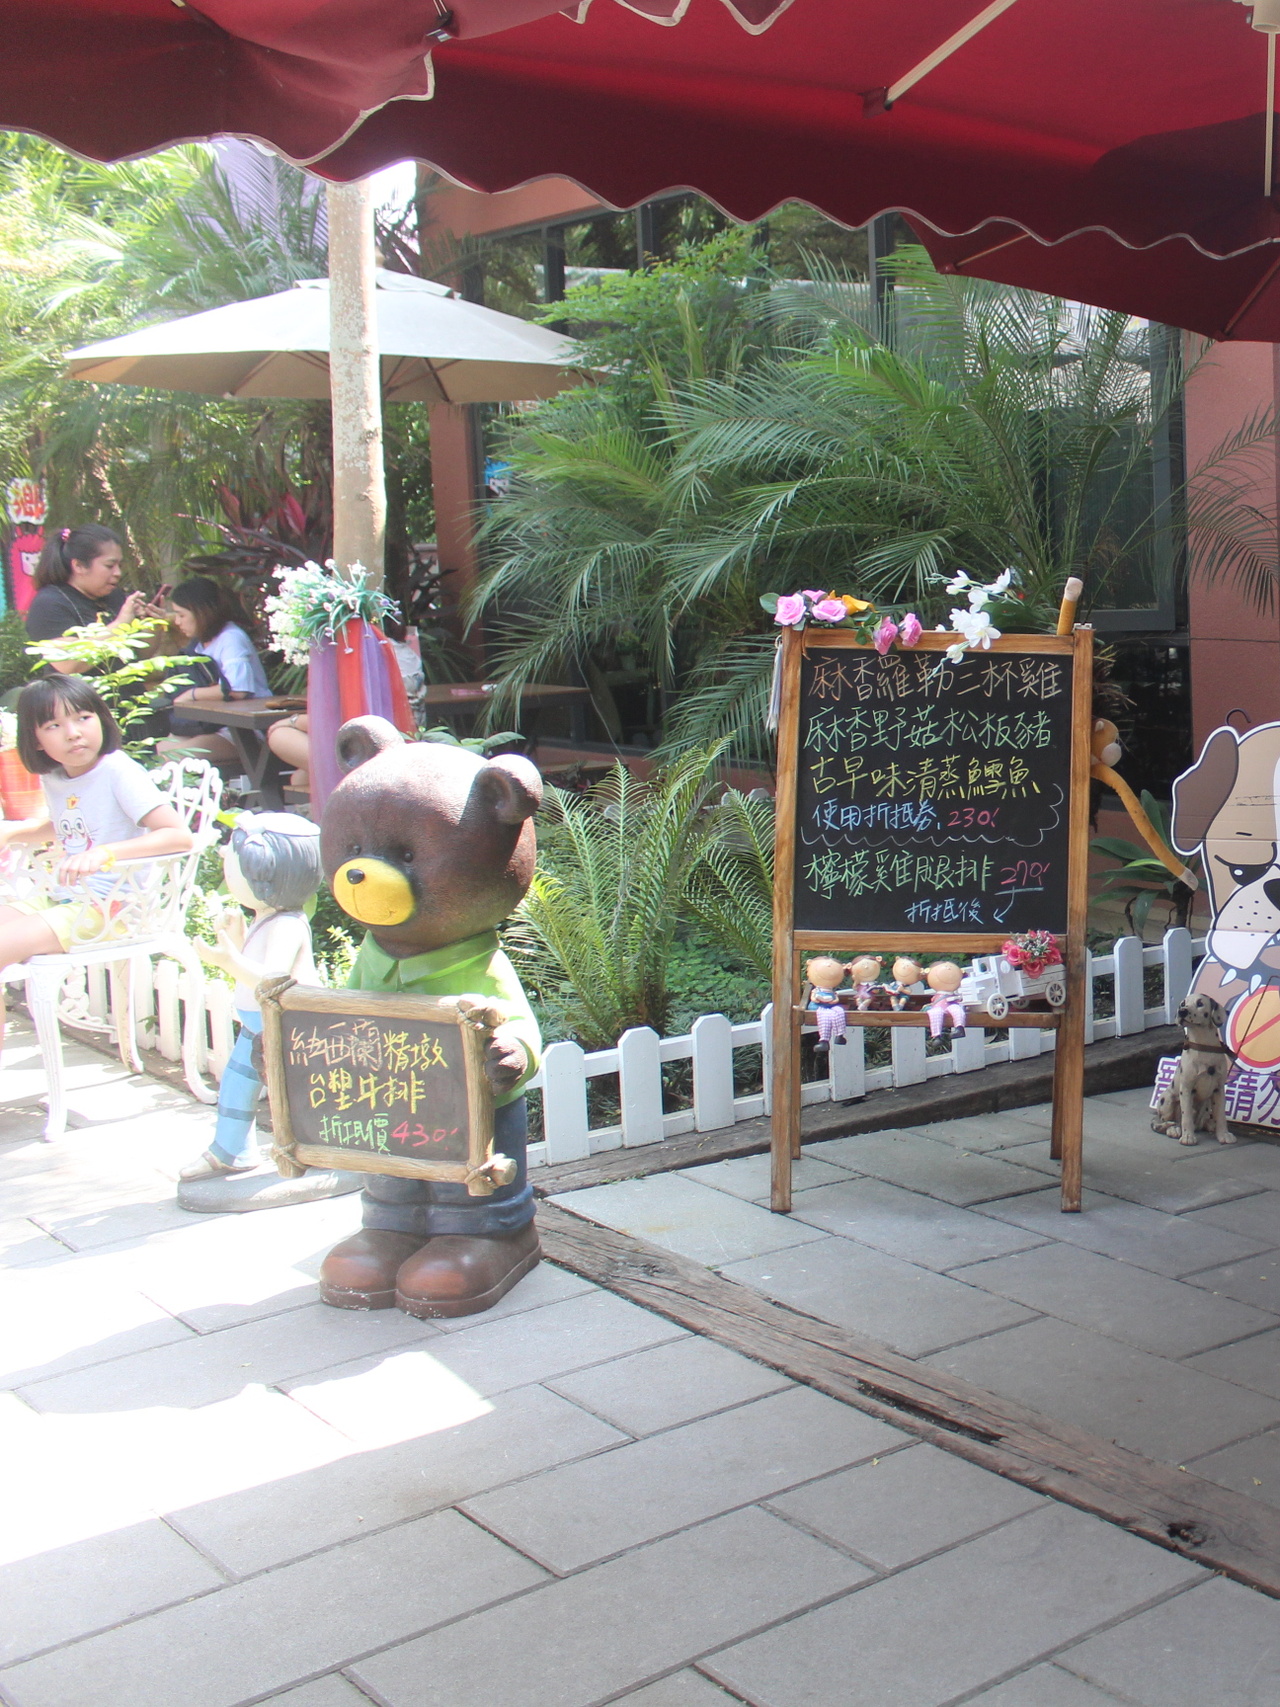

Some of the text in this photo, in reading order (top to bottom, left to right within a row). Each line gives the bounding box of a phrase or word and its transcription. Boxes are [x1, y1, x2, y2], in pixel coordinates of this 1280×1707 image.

[803, 704, 1052, 751] 麻香野菇松板豬
[810, 754, 1041, 801] 古早味清蒸鱈魚
[802, 848, 995, 900] 檸檬雞腿排
[904, 898, 985, 924] 折抵後
